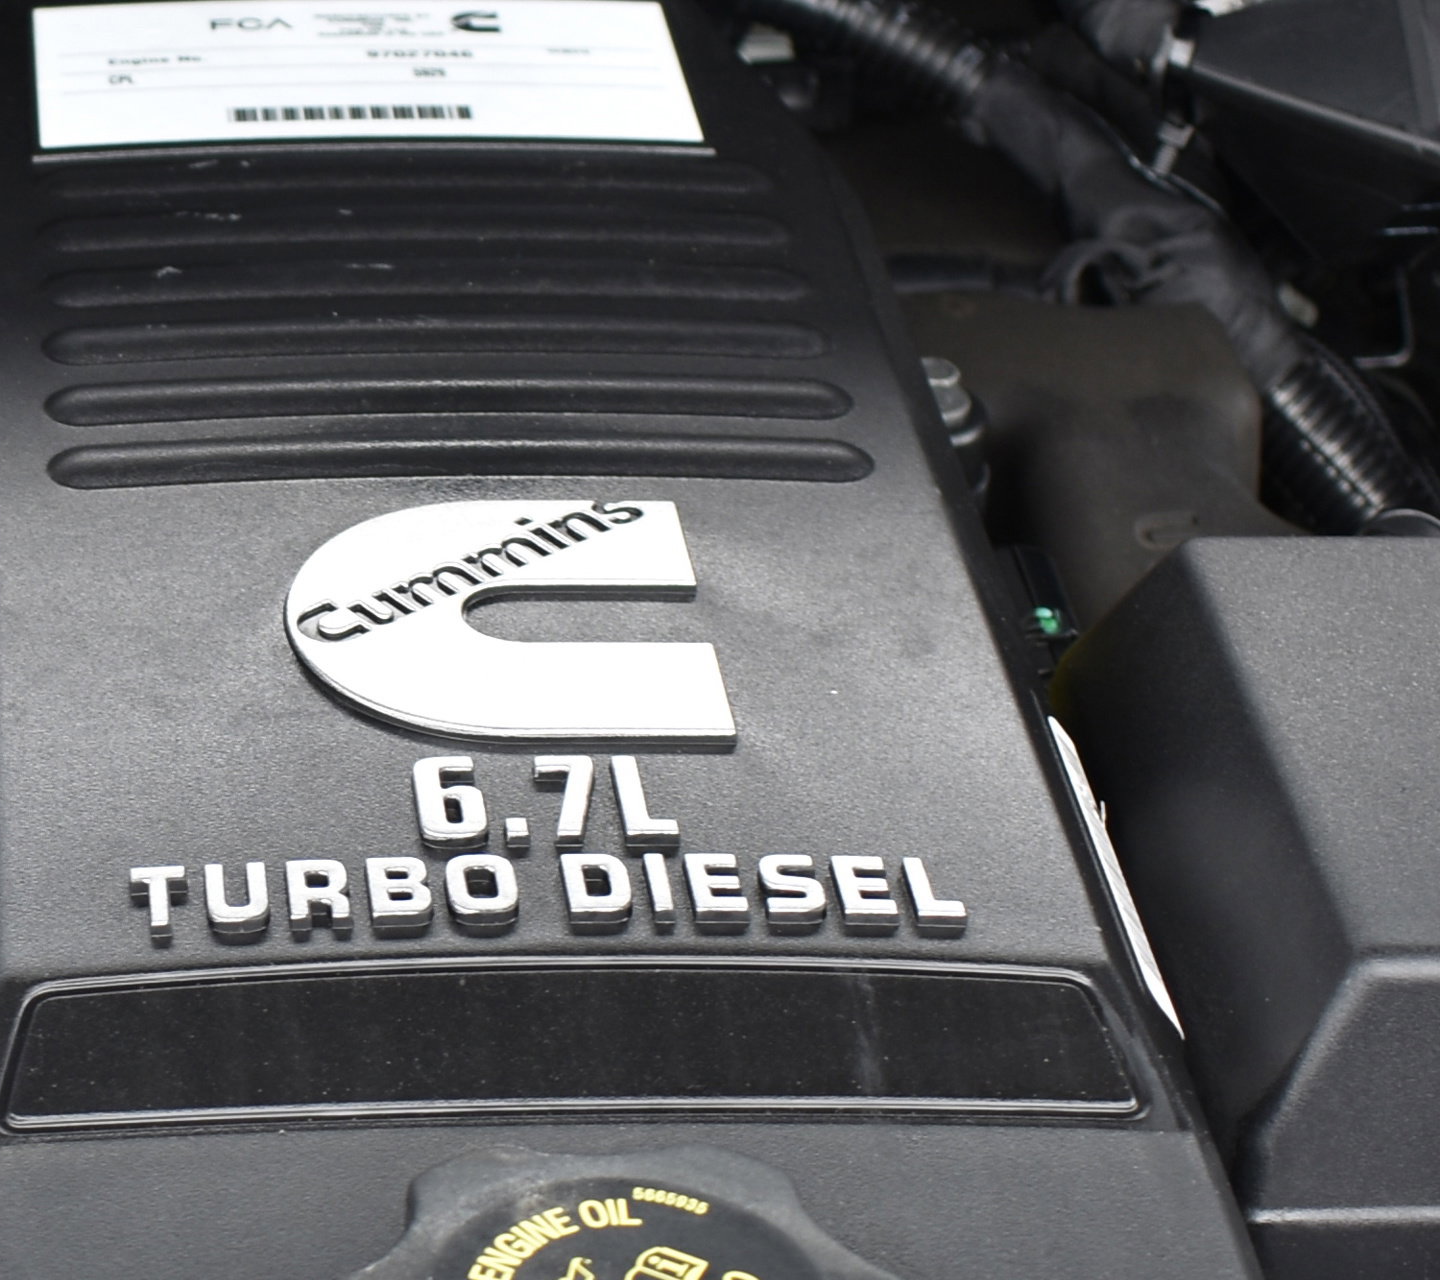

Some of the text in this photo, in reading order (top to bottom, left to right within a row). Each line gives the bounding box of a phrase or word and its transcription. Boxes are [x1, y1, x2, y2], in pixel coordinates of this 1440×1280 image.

[210, 17, 293, 31] FCA
[297, 500, 645, 642] Cummins
[409, 754, 683, 851] 6.7L
[129, 851, 969, 938] TURBO DIESEL
[577, 1198, 643, 1229] OIL
